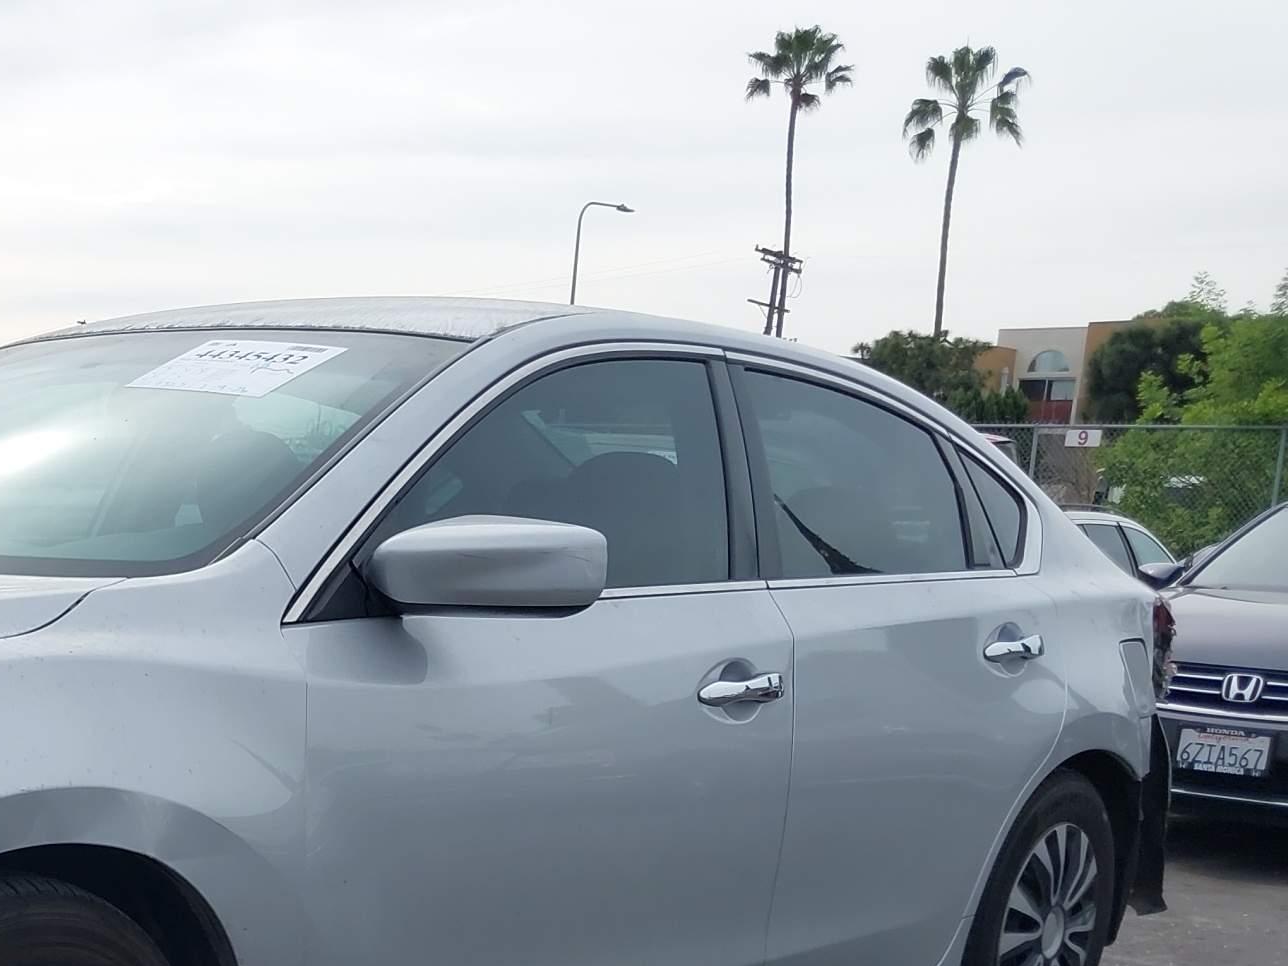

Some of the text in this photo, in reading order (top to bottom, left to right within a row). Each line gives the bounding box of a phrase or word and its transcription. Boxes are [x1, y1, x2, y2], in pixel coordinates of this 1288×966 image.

[196, 349, 309, 365] 44345432
[1078, 430, 1089, 446] 9
[1206, 727, 1246, 736] HONDA
[1180, 742, 1264, 770] 6ZIA567
